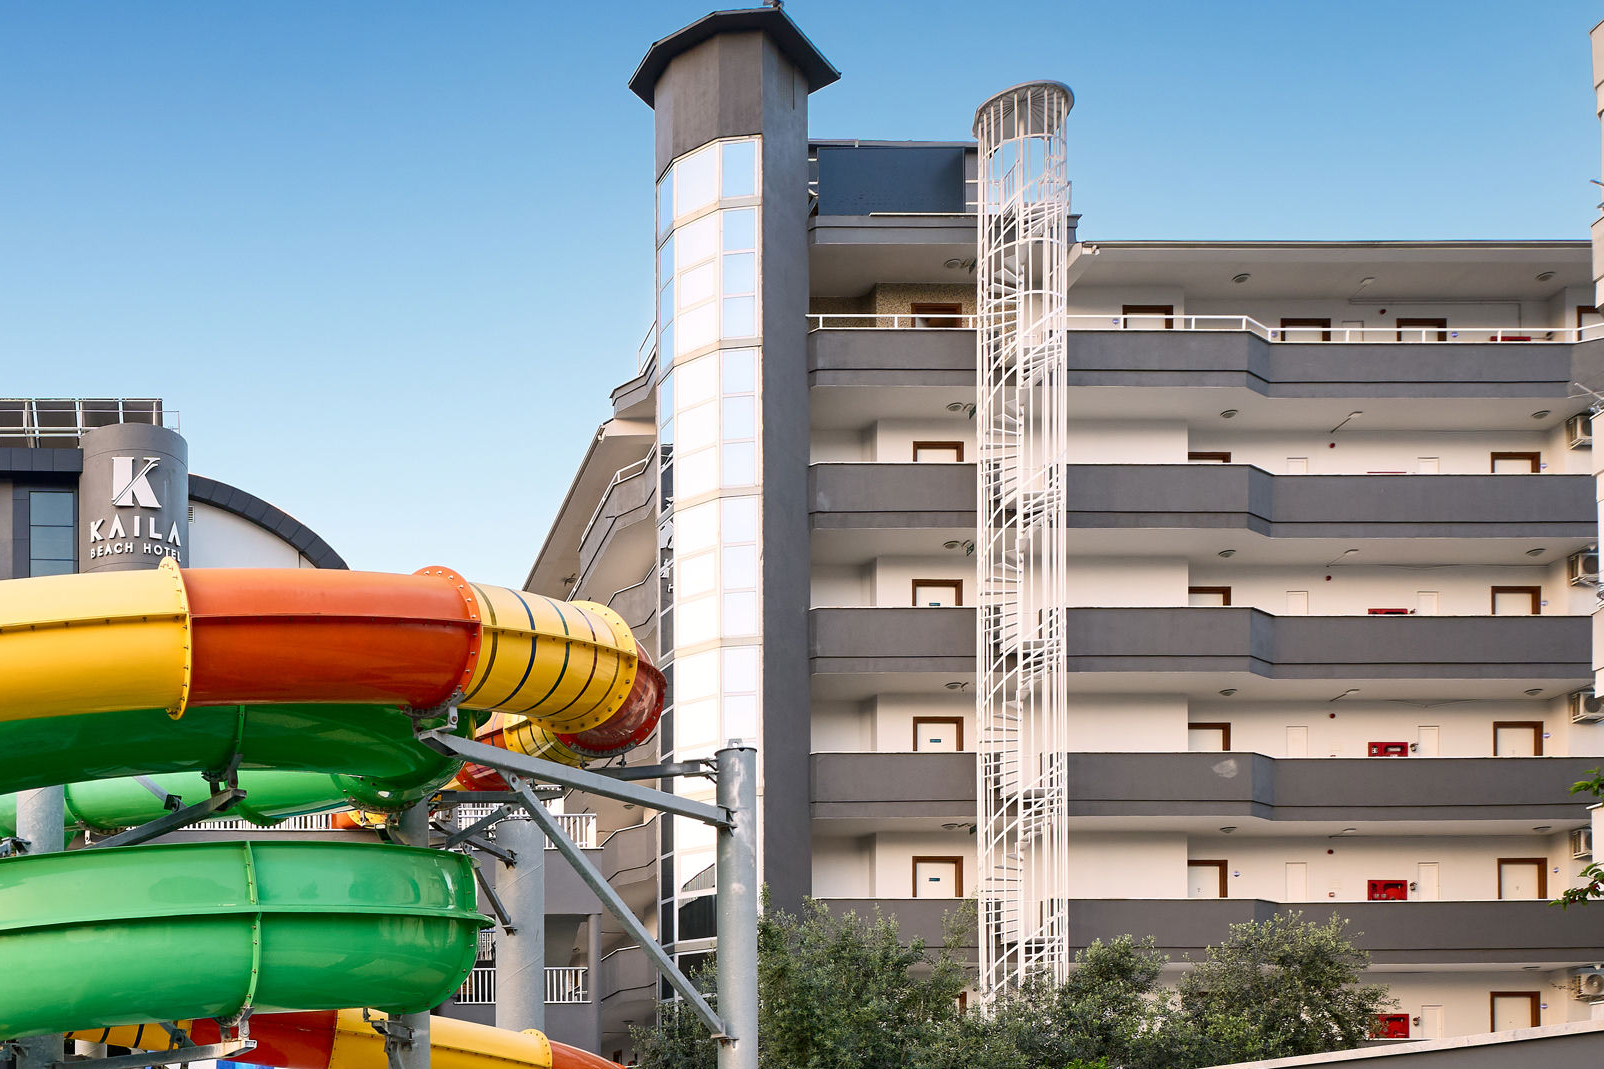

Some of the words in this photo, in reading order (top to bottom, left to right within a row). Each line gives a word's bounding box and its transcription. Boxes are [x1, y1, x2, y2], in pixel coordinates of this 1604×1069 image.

[111, 456, 162, 508] K
[90, 513, 181, 547] KAILA
[90, 542, 134, 560] BEACH
[143, 542, 181, 562] HOTEL
